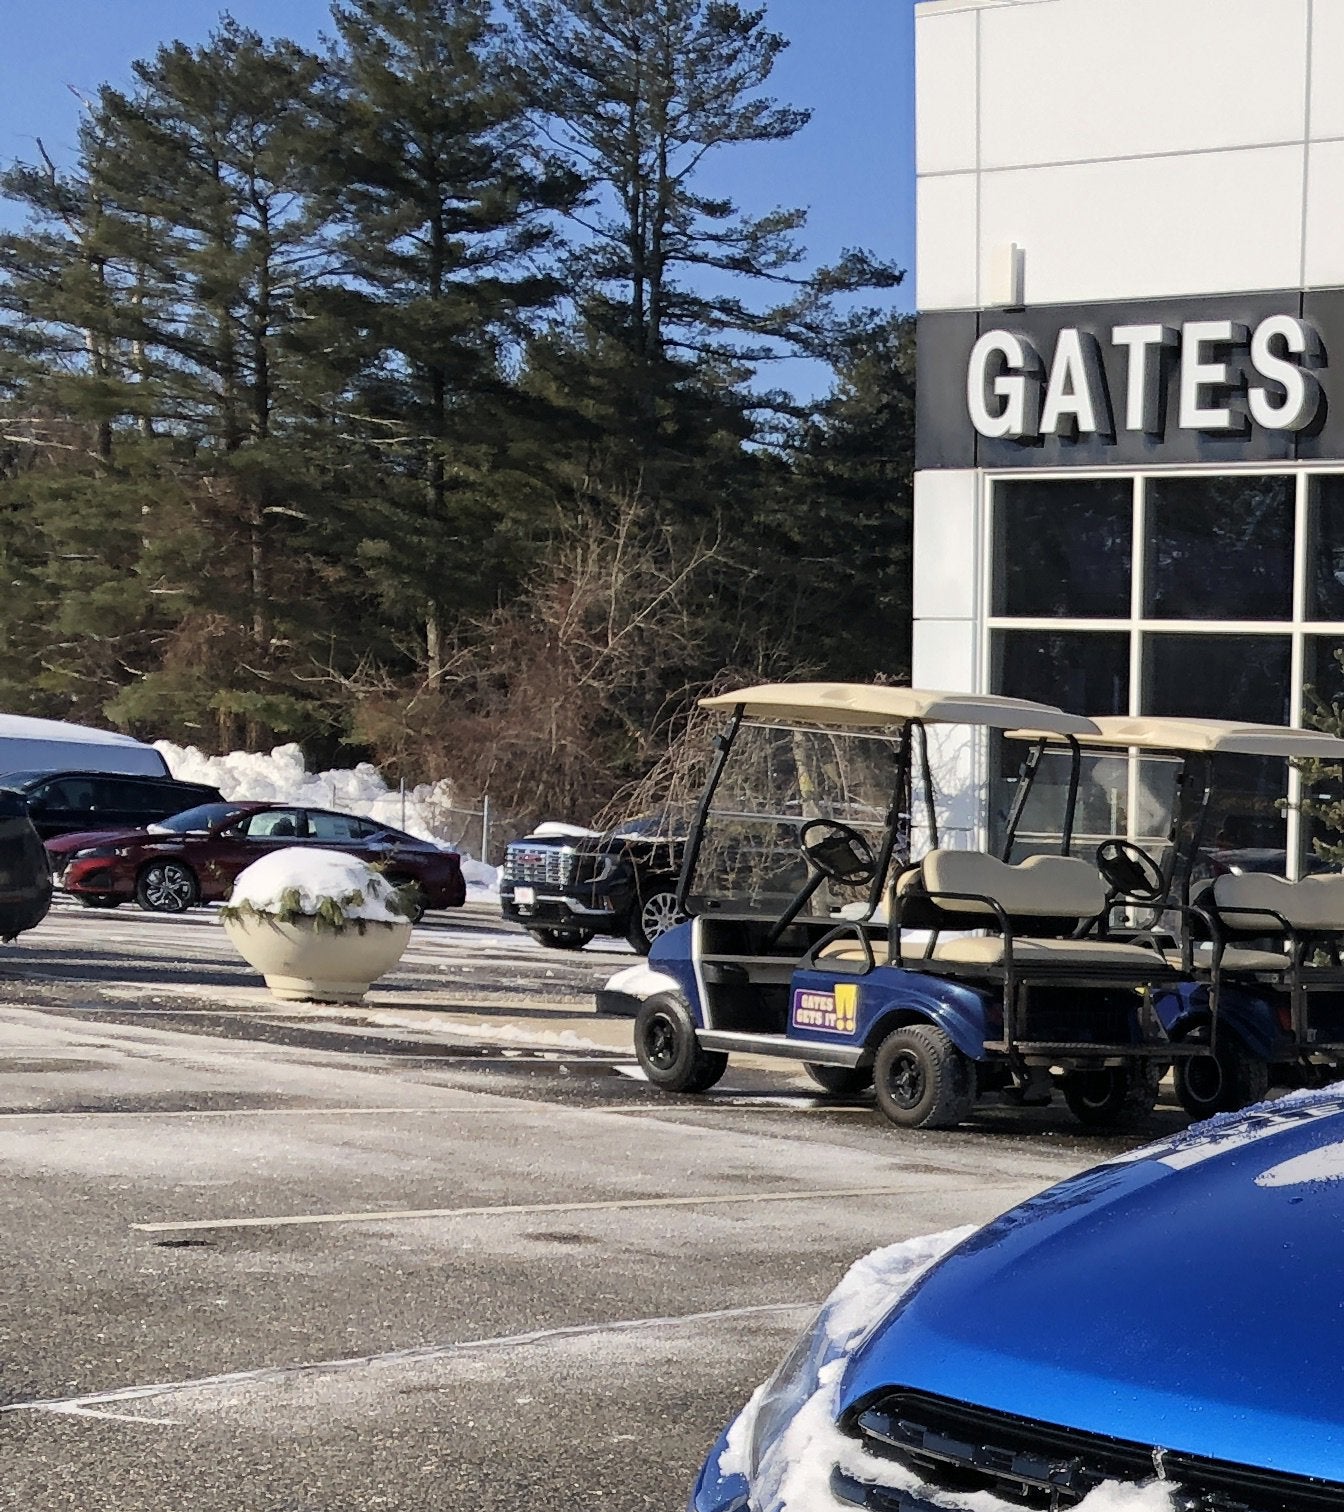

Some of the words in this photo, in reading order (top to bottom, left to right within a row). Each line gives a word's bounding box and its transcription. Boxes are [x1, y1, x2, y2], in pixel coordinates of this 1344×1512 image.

[967, 314, 1306, 438] GATES
[801, 994, 834, 1011] GATES
[796, 1009, 823, 1025] GETS
